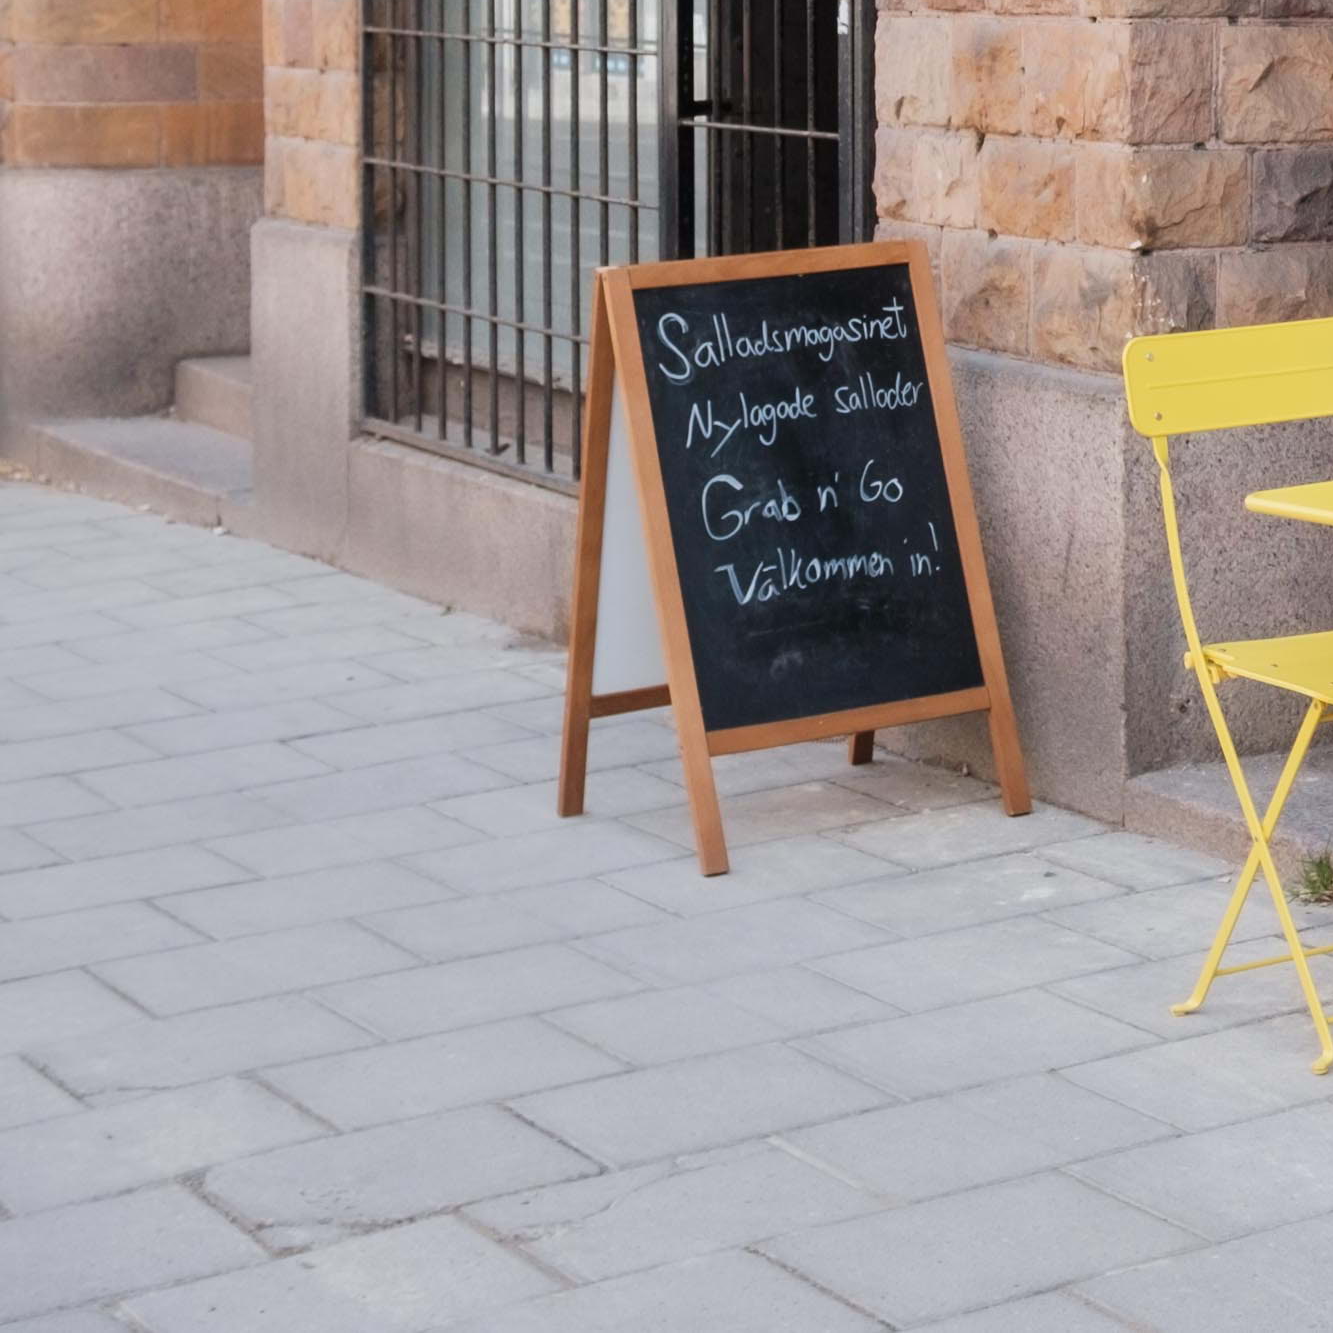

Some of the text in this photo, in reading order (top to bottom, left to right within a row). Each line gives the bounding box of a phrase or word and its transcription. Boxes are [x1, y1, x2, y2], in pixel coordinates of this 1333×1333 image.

[657, 297, 908, 385] Salladsmagasinet
[702, 474, 801, 541] Grab
[860, 459, 904, 503] Go
[714, 522, 941, 606] Välkommen in!
